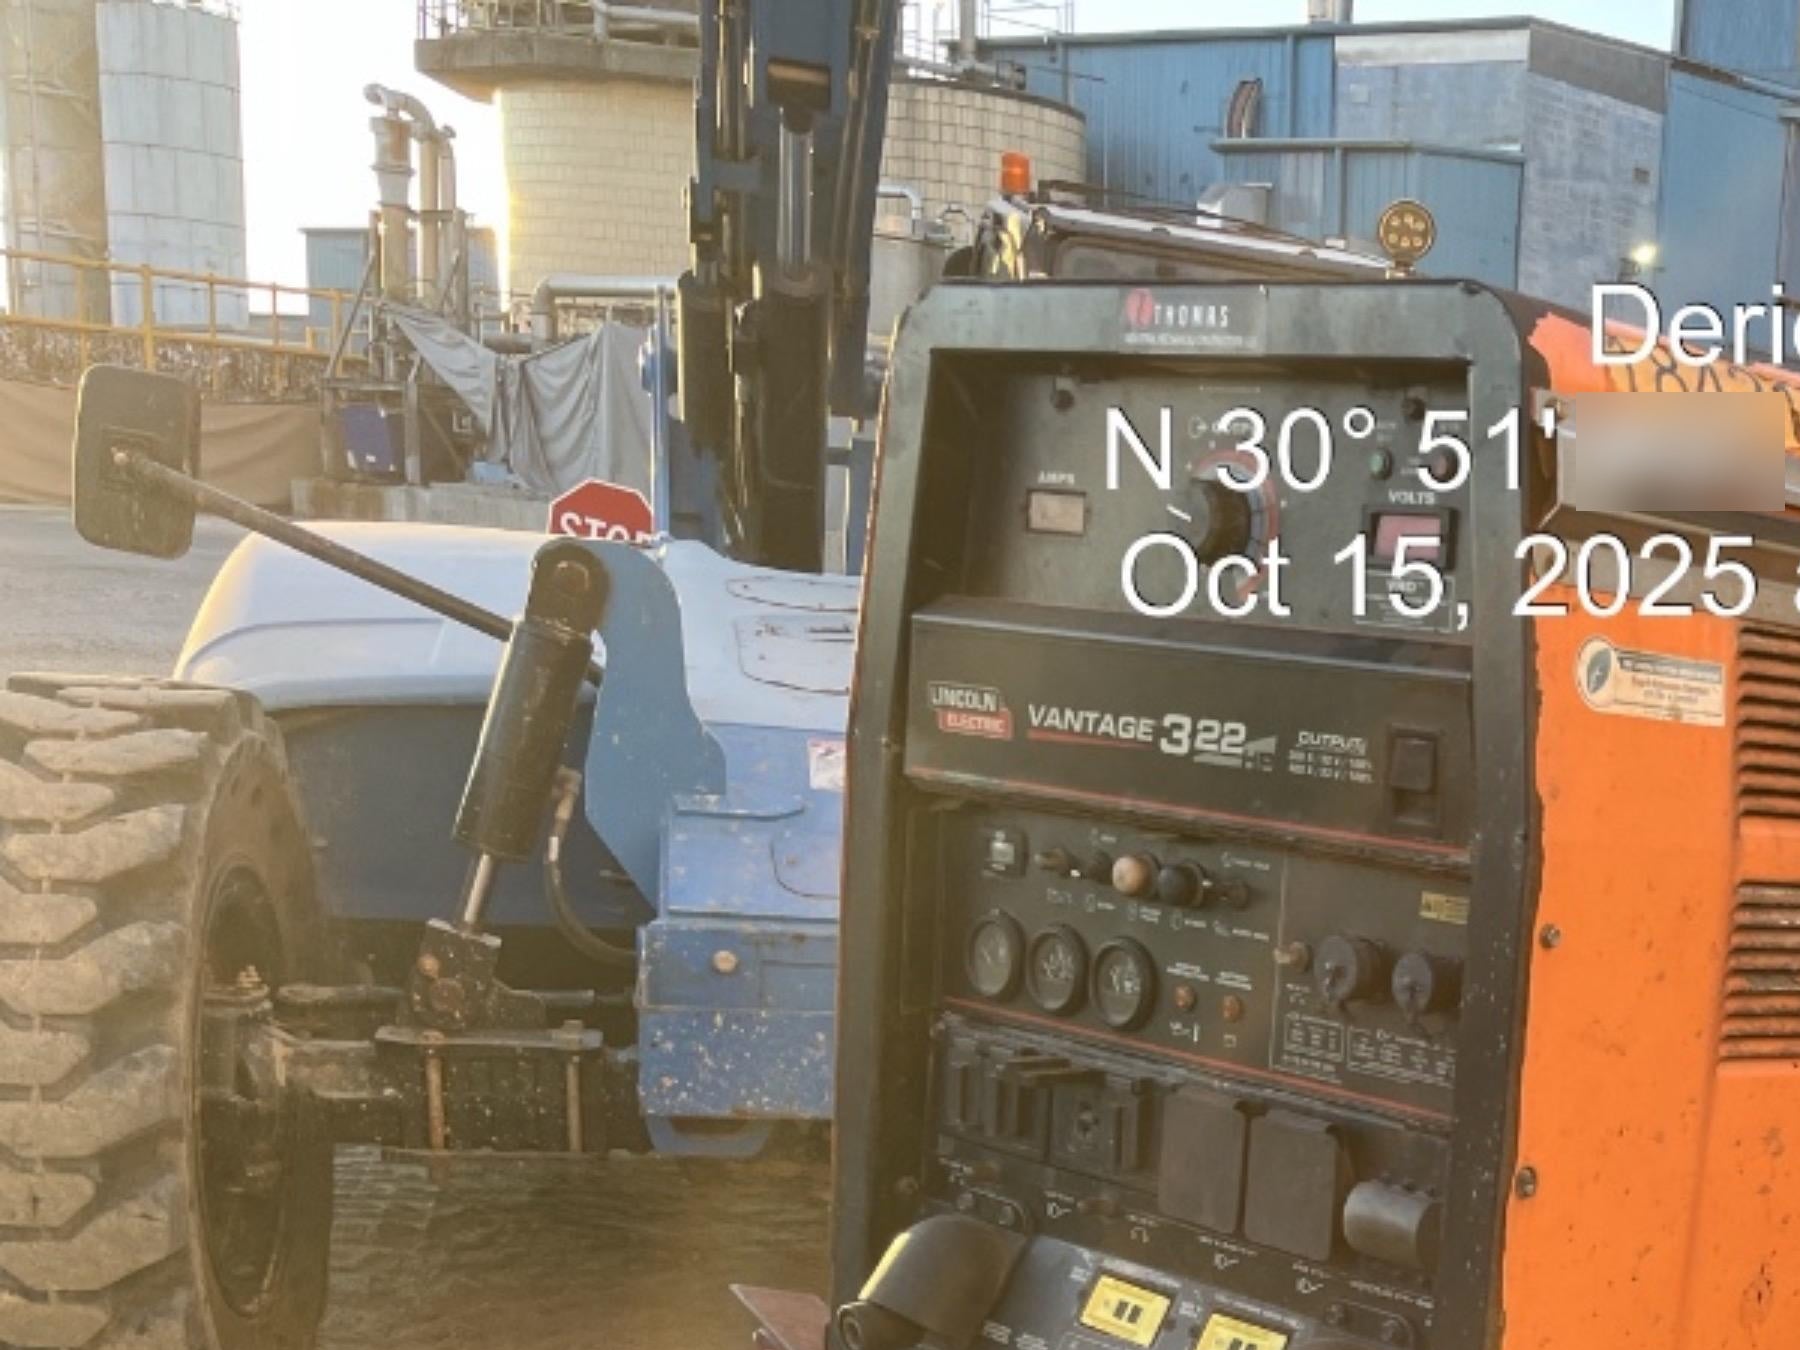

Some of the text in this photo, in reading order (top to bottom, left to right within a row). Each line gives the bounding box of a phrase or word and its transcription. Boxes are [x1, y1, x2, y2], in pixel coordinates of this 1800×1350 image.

[1387, 489, 1436, 505] VOLTS
[930, 685, 998, 713] LINCOLN
[946, 712, 1006, 733] ELECTRIC
[1027, 703, 1248, 756] VANTAGE 322
